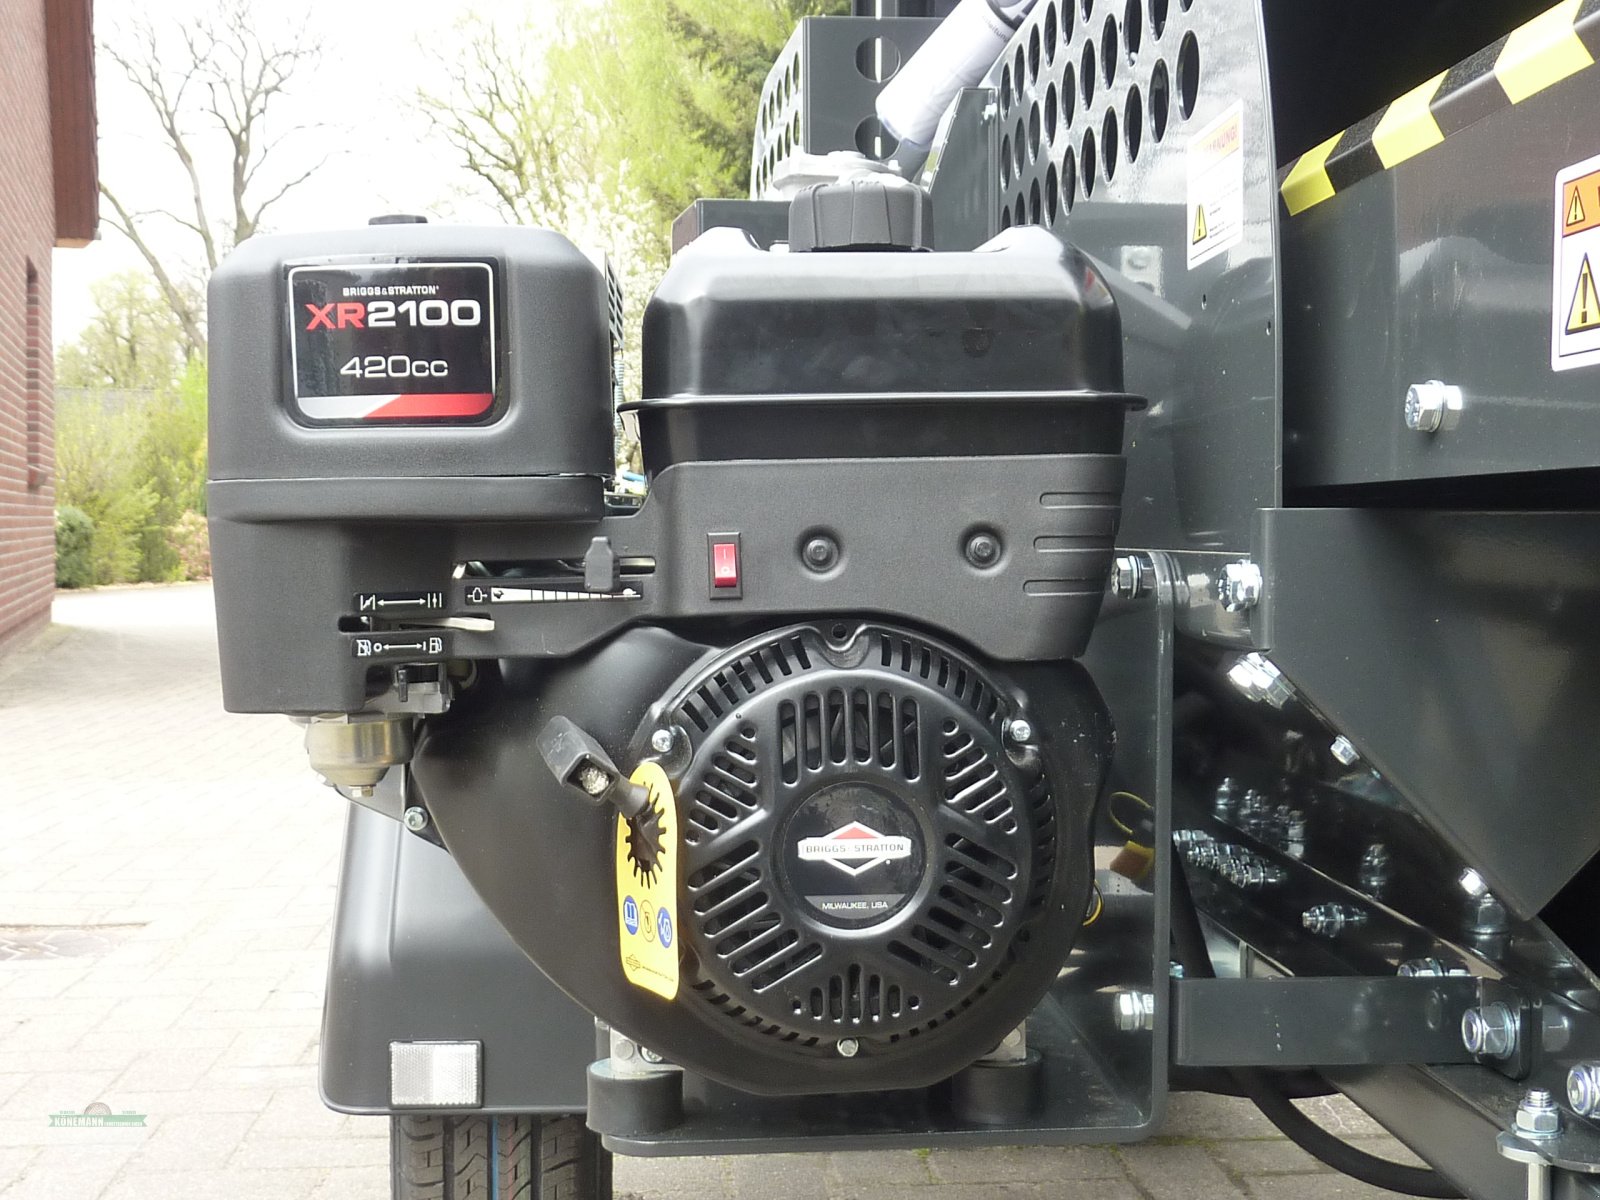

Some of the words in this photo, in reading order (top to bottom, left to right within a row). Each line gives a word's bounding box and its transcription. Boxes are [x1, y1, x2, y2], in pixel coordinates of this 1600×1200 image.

[305, 299, 481, 331] XR2100
[339, 355, 449, 379] 420cc
[806, 844, 846, 853] BRIGGS
[854, 843, 904, 853] STRATTON
[871, 901, 889, 909] USA
